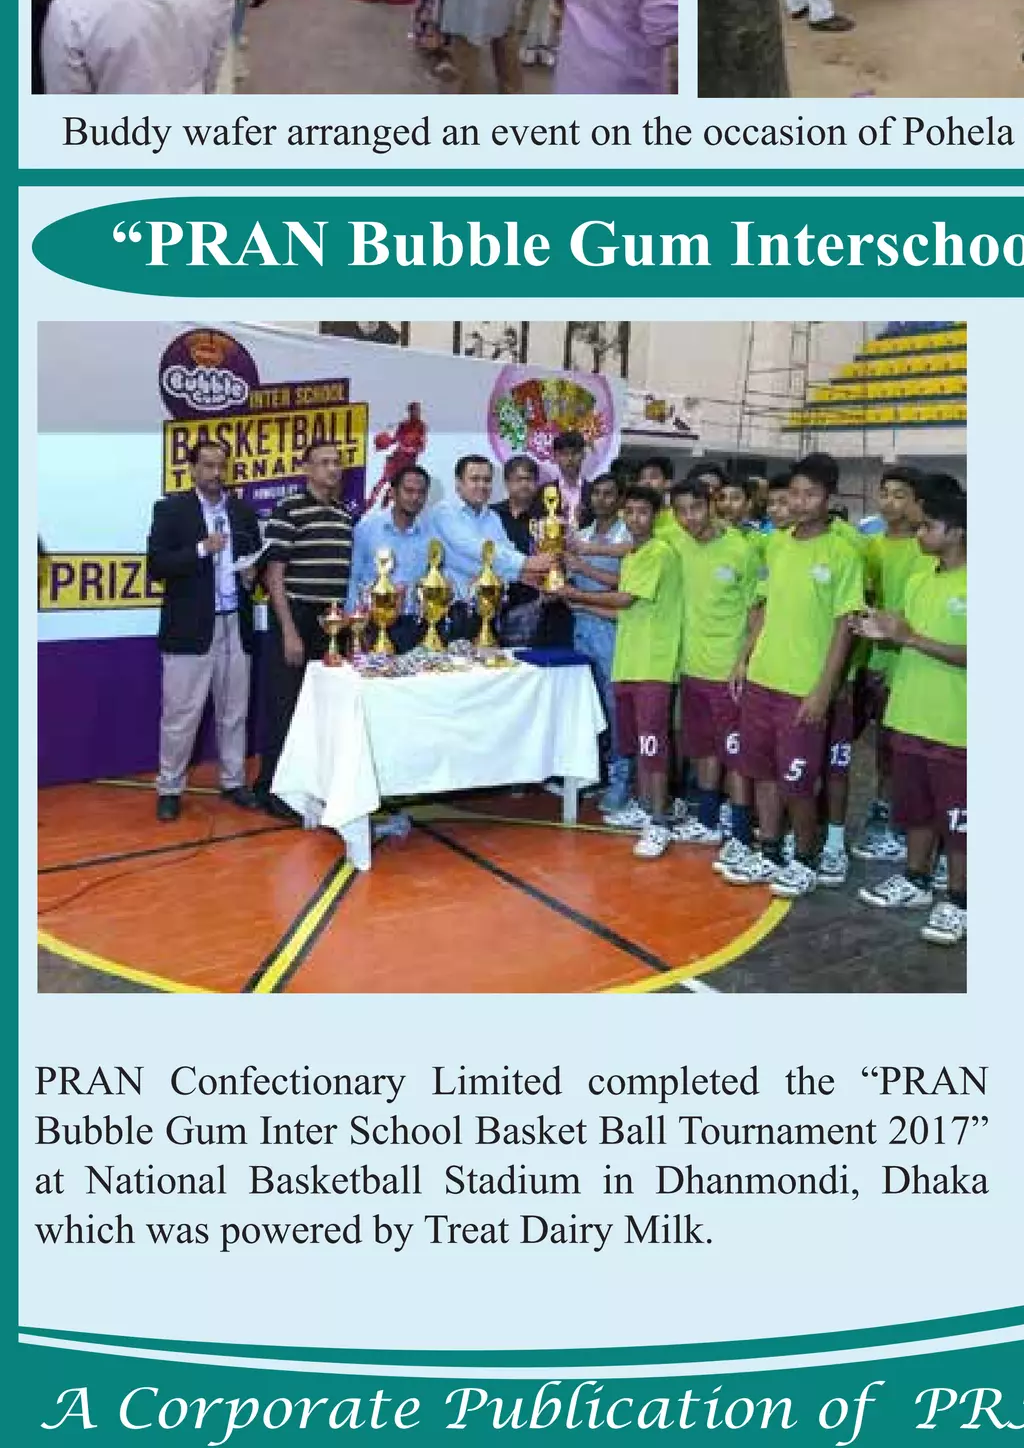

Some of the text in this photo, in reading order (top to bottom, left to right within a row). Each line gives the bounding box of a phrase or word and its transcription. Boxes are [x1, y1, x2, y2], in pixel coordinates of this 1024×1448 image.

[62, 115, 172, 155] Buddy
[182, 115, 277, 146] wafer
[287, 115, 432, 155] arranged
[442, 125, 481, 146] an
[491, 120, 581, 146] event
[591, 125, 632, 146] on
[642, 115, 692, 146] the
[703, 115, 848, 146] occasion
[858, 115, 897, 146] of
[902, 115, 1015, 146] Pohela
[112, 220, 329, 267] “PRAN
[347, 221, 551, 267] Bubble
[569, 220, 712, 267] Gum
[169, 369, 244, 399] Bubble
[171, 409, 358, 466] BASKETBALL
[639, 734, 657, 757] 10
[725, 731, 740, 755] 6
[829, 742, 852, 767] 13
[783, 757, 807, 782] 5
[34, 1065, 989, 1104] PRAN Confectionary Limited completed the “PRAN
[34, 1114, 989, 1145] Bubble Gum Inter School Basket Ball Tournament 2017”
[34, 1213, 712, 1253] which was powered by Treat Dairy Milk.
[40, 1386, 98, 1430] A
[119, 1386, 421, 1447] Corporate
[444, 1379, 798, 1430] Publication
[818, 1380, 886, 1447] of
